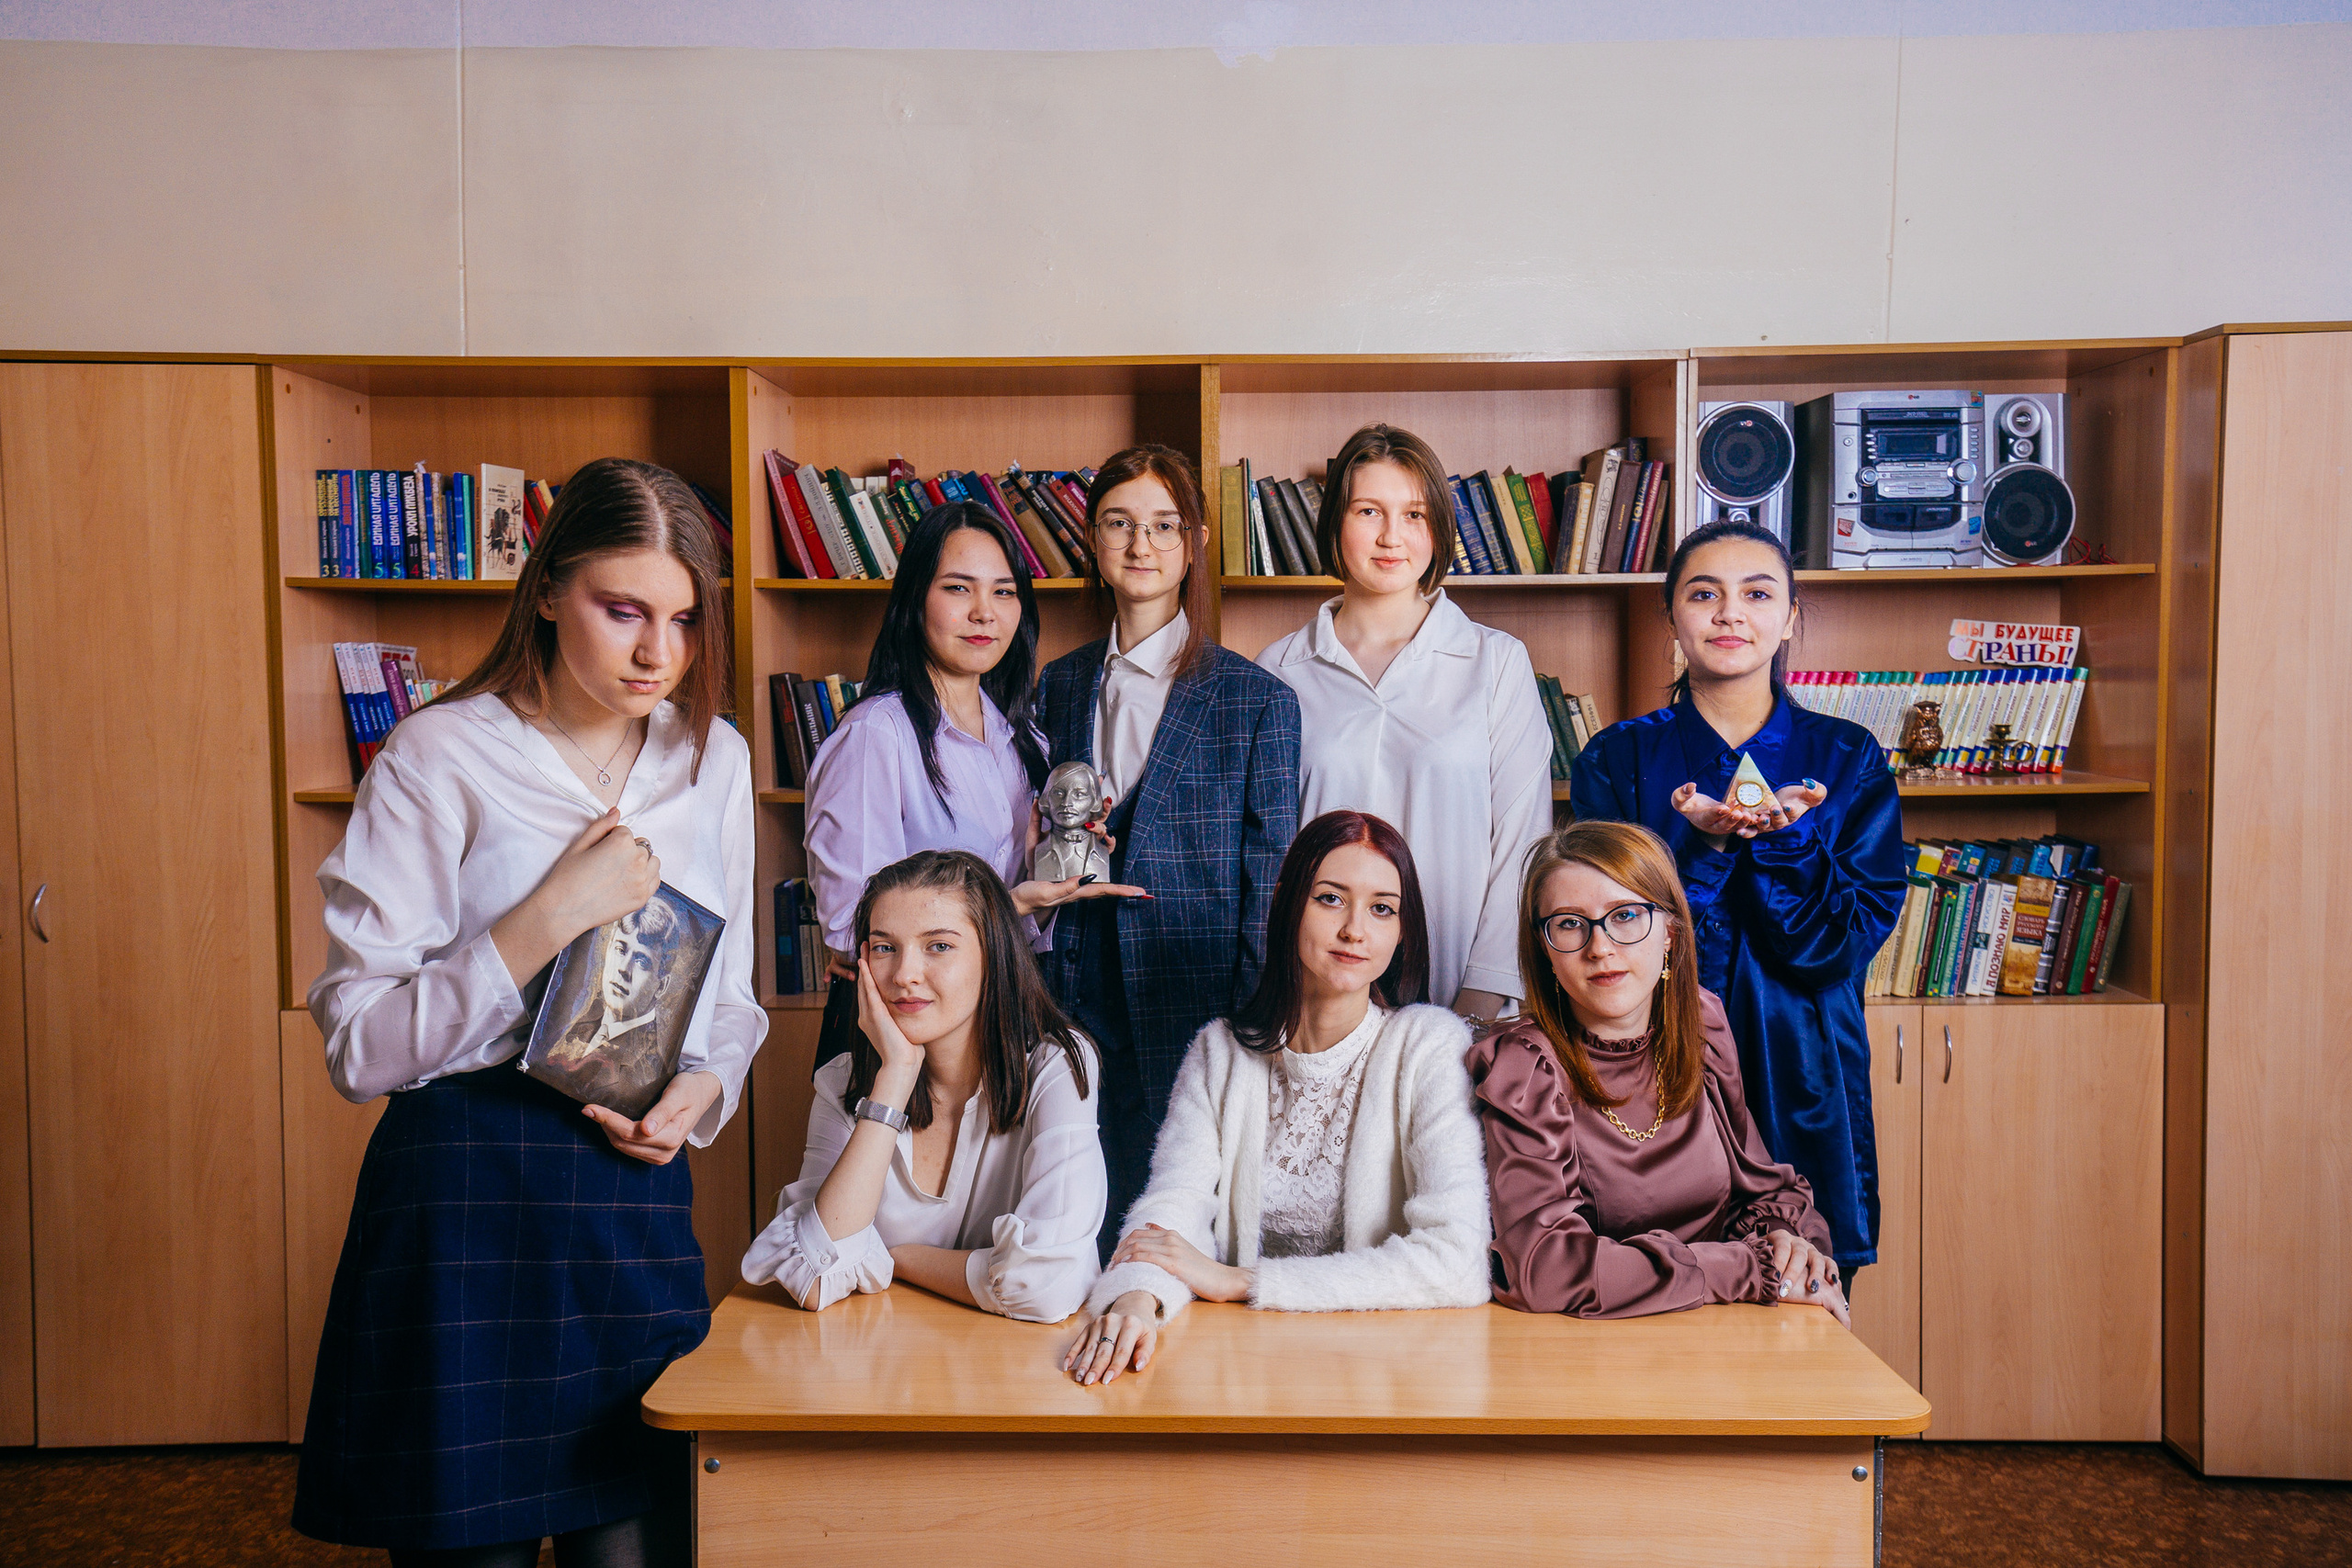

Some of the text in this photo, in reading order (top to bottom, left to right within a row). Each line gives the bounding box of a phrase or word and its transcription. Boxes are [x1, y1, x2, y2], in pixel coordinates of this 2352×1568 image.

[370, 472, 383, 545] ЕДИНАЯ ЦИТАДЕЛЬ
[388, 473, 401, 546] ЕДИНАЯ ЦИТАДЕЛЬ
[402, 476, 418, 536] УРОКИ ЛИКБЕЗА
[1955, 621, 2074, 643] МЫ БУДУЩЕЕ
[1950, 638, 2074, 665] СТРАНЫ!
[804, 704, 820, 743] ПИЛЬНЯК
[1588, 705, 1598, 731] ЕСЕНИН
[2017, 927, 2042, 936] ЯЗЫКА
[2018, 916, 2045, 924] СЛОВАРЬ
[1985, 907, 2011, 987] Я ПОЗНАЮ МИР
